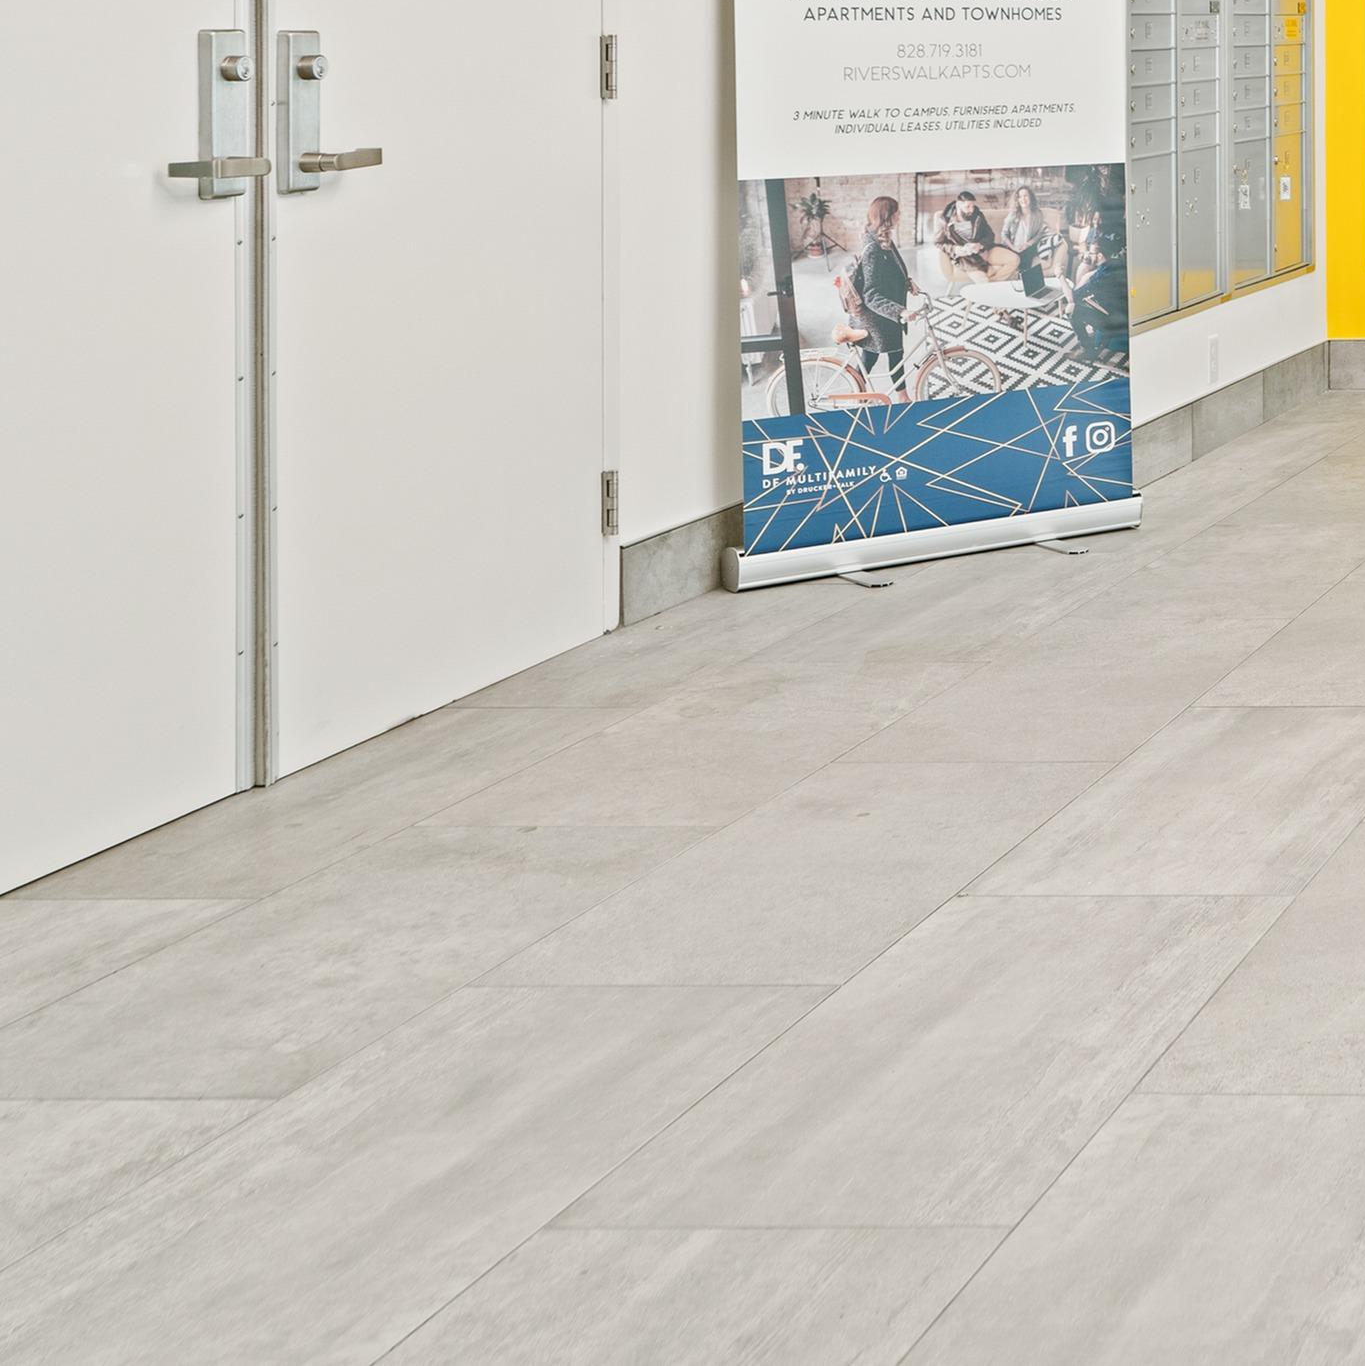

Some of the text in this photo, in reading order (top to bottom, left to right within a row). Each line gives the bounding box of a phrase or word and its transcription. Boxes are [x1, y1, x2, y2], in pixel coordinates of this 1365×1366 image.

[803, 7, 1062, 21] APARTMENTS AND TOWNHOMES
[896, 43, 982, 58] 828.719.3181
[843, 64, 1031, 81] RIVERSWALKAPTS.COM
[793, 110, 800, 121] 3
[803, 109, 845, 120] MINUTE
[849, 109, 882, 119] WALK
[886, 108, 900, 118] TO
[953, 105, 1008, 115] FURNISHED
[835, 123, 896, 134] INDIVIDUAL
[945, 119, 991, 130] UTILITIES
[993, 117, 1041, 129] INCLUDED
[763, 477, 780, 489] DF
